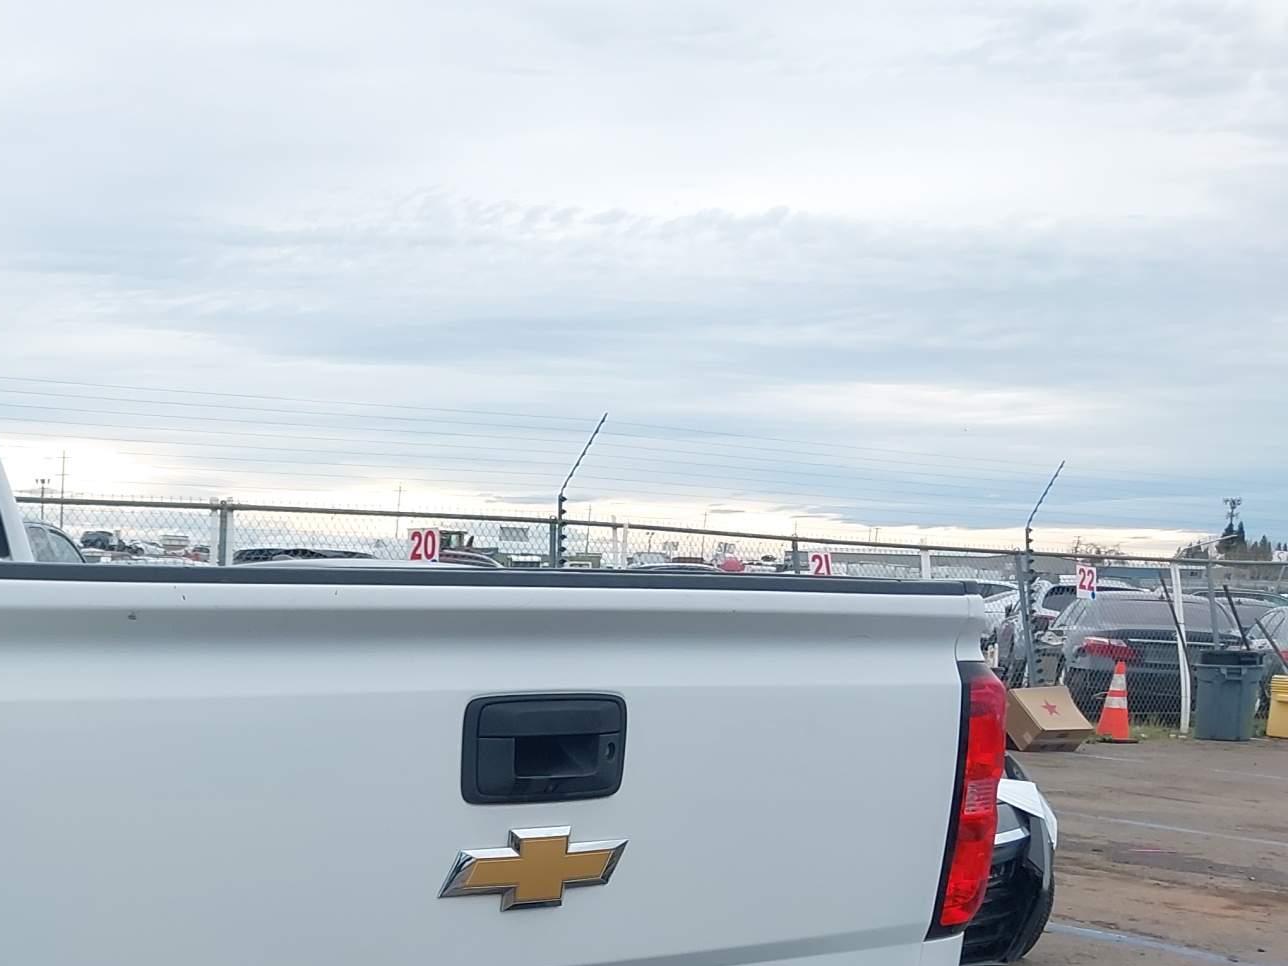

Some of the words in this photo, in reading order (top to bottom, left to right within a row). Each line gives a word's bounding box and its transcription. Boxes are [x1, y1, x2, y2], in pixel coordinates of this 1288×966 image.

[410, 530, 436, 560] 20
[811, 554, 831, 575] 21
[1078, 567, 1095, 591] 22
